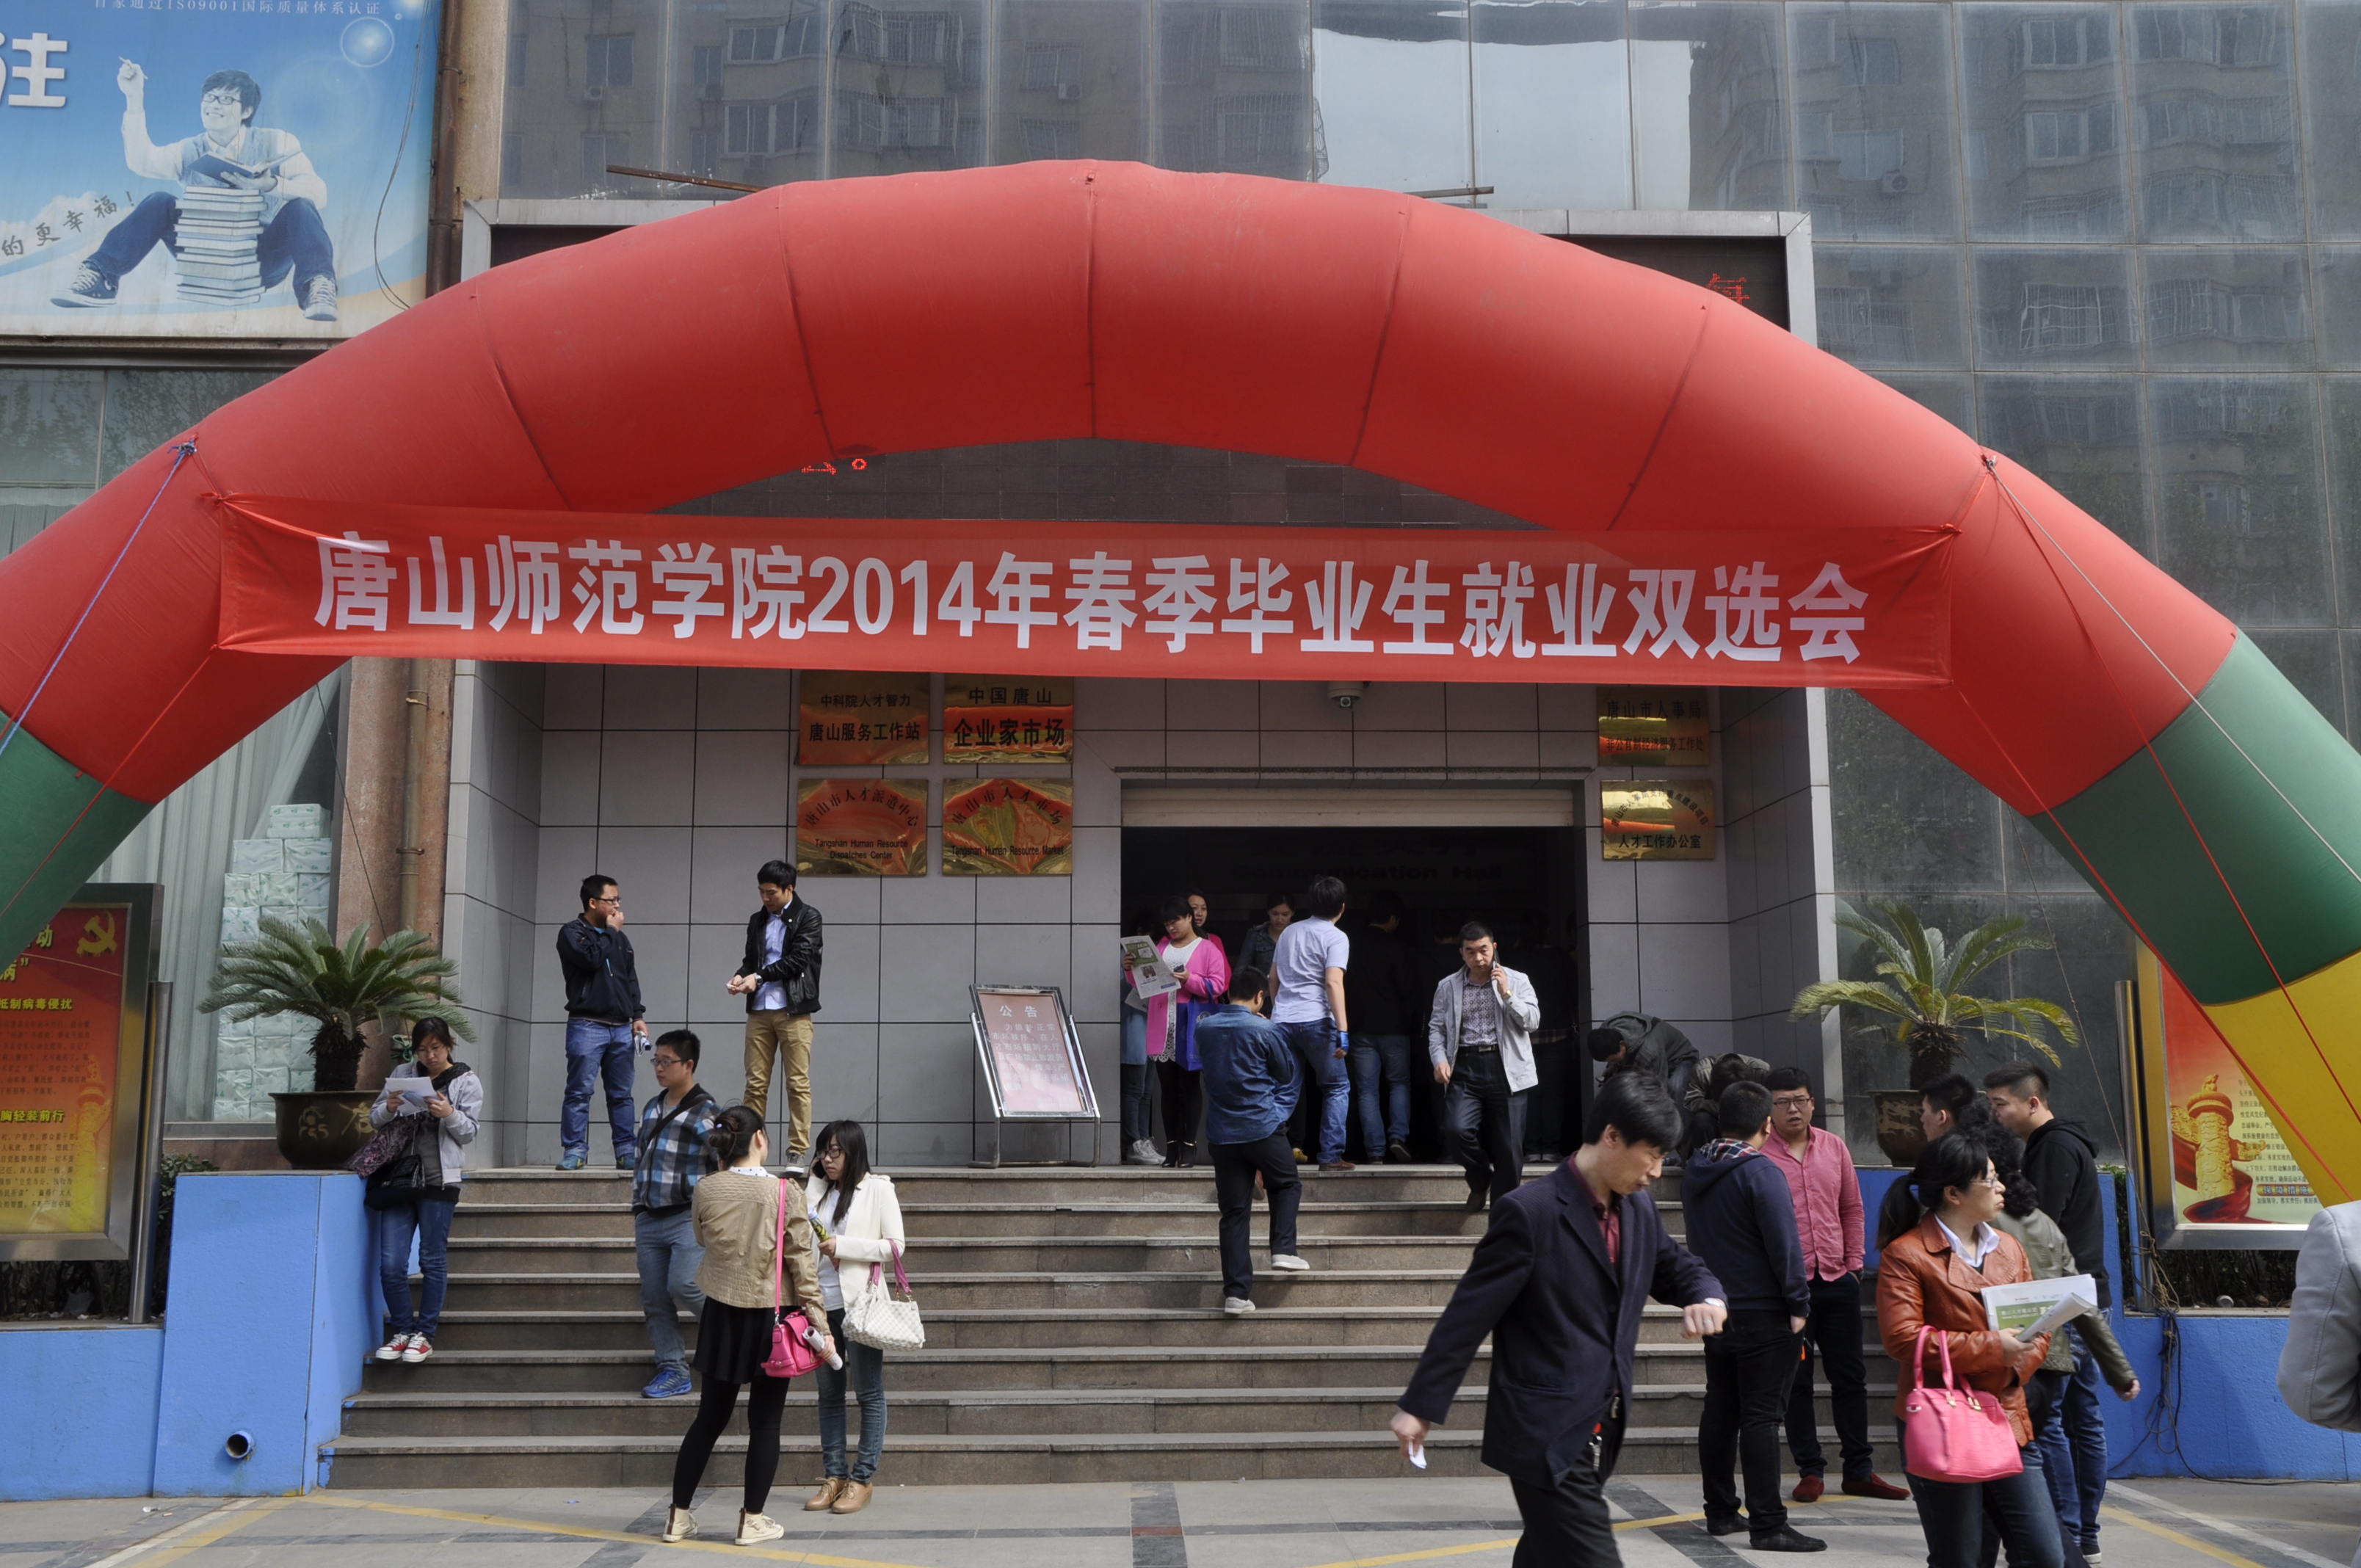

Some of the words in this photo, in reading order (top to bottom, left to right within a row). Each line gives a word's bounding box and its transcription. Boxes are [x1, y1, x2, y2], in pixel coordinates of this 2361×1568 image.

[314, 530, 1869, 664] 唐山师范学院2014年春季毕业生就业双选会
[820, 693, 911, 708] 中科院人才智力
[968, 686, 1052, 705] 中国唐山
[1606, 700, 1702, 719] 唐山市人事局
[808, 722, 921, 742] 唐山服务工作站
[953, 717, 1065, 747] 企业家市场
[805, 786, 919, 827] 唐山市人才派遣中心
[952, 786, 1065, 826] 唐山市人才市场
[816, 838, 848, 849] Tangshan
[850, 839, 874, 848] Human
[877, 839, 908, 848] Resource
[951, 845, 982, 857] Tangshan
[984, 846, 1007, 855] Human
[1009, 846, 1040, 855] Resource
[1042, 846, 1065, 855] Market
[1618, 834, 1702, 849] 人才工作办公室
[830, 851, 867, 860] Dispatches
[870, 851, 893, 860] Center
[999, 1005, 1038, 1017] 公告
